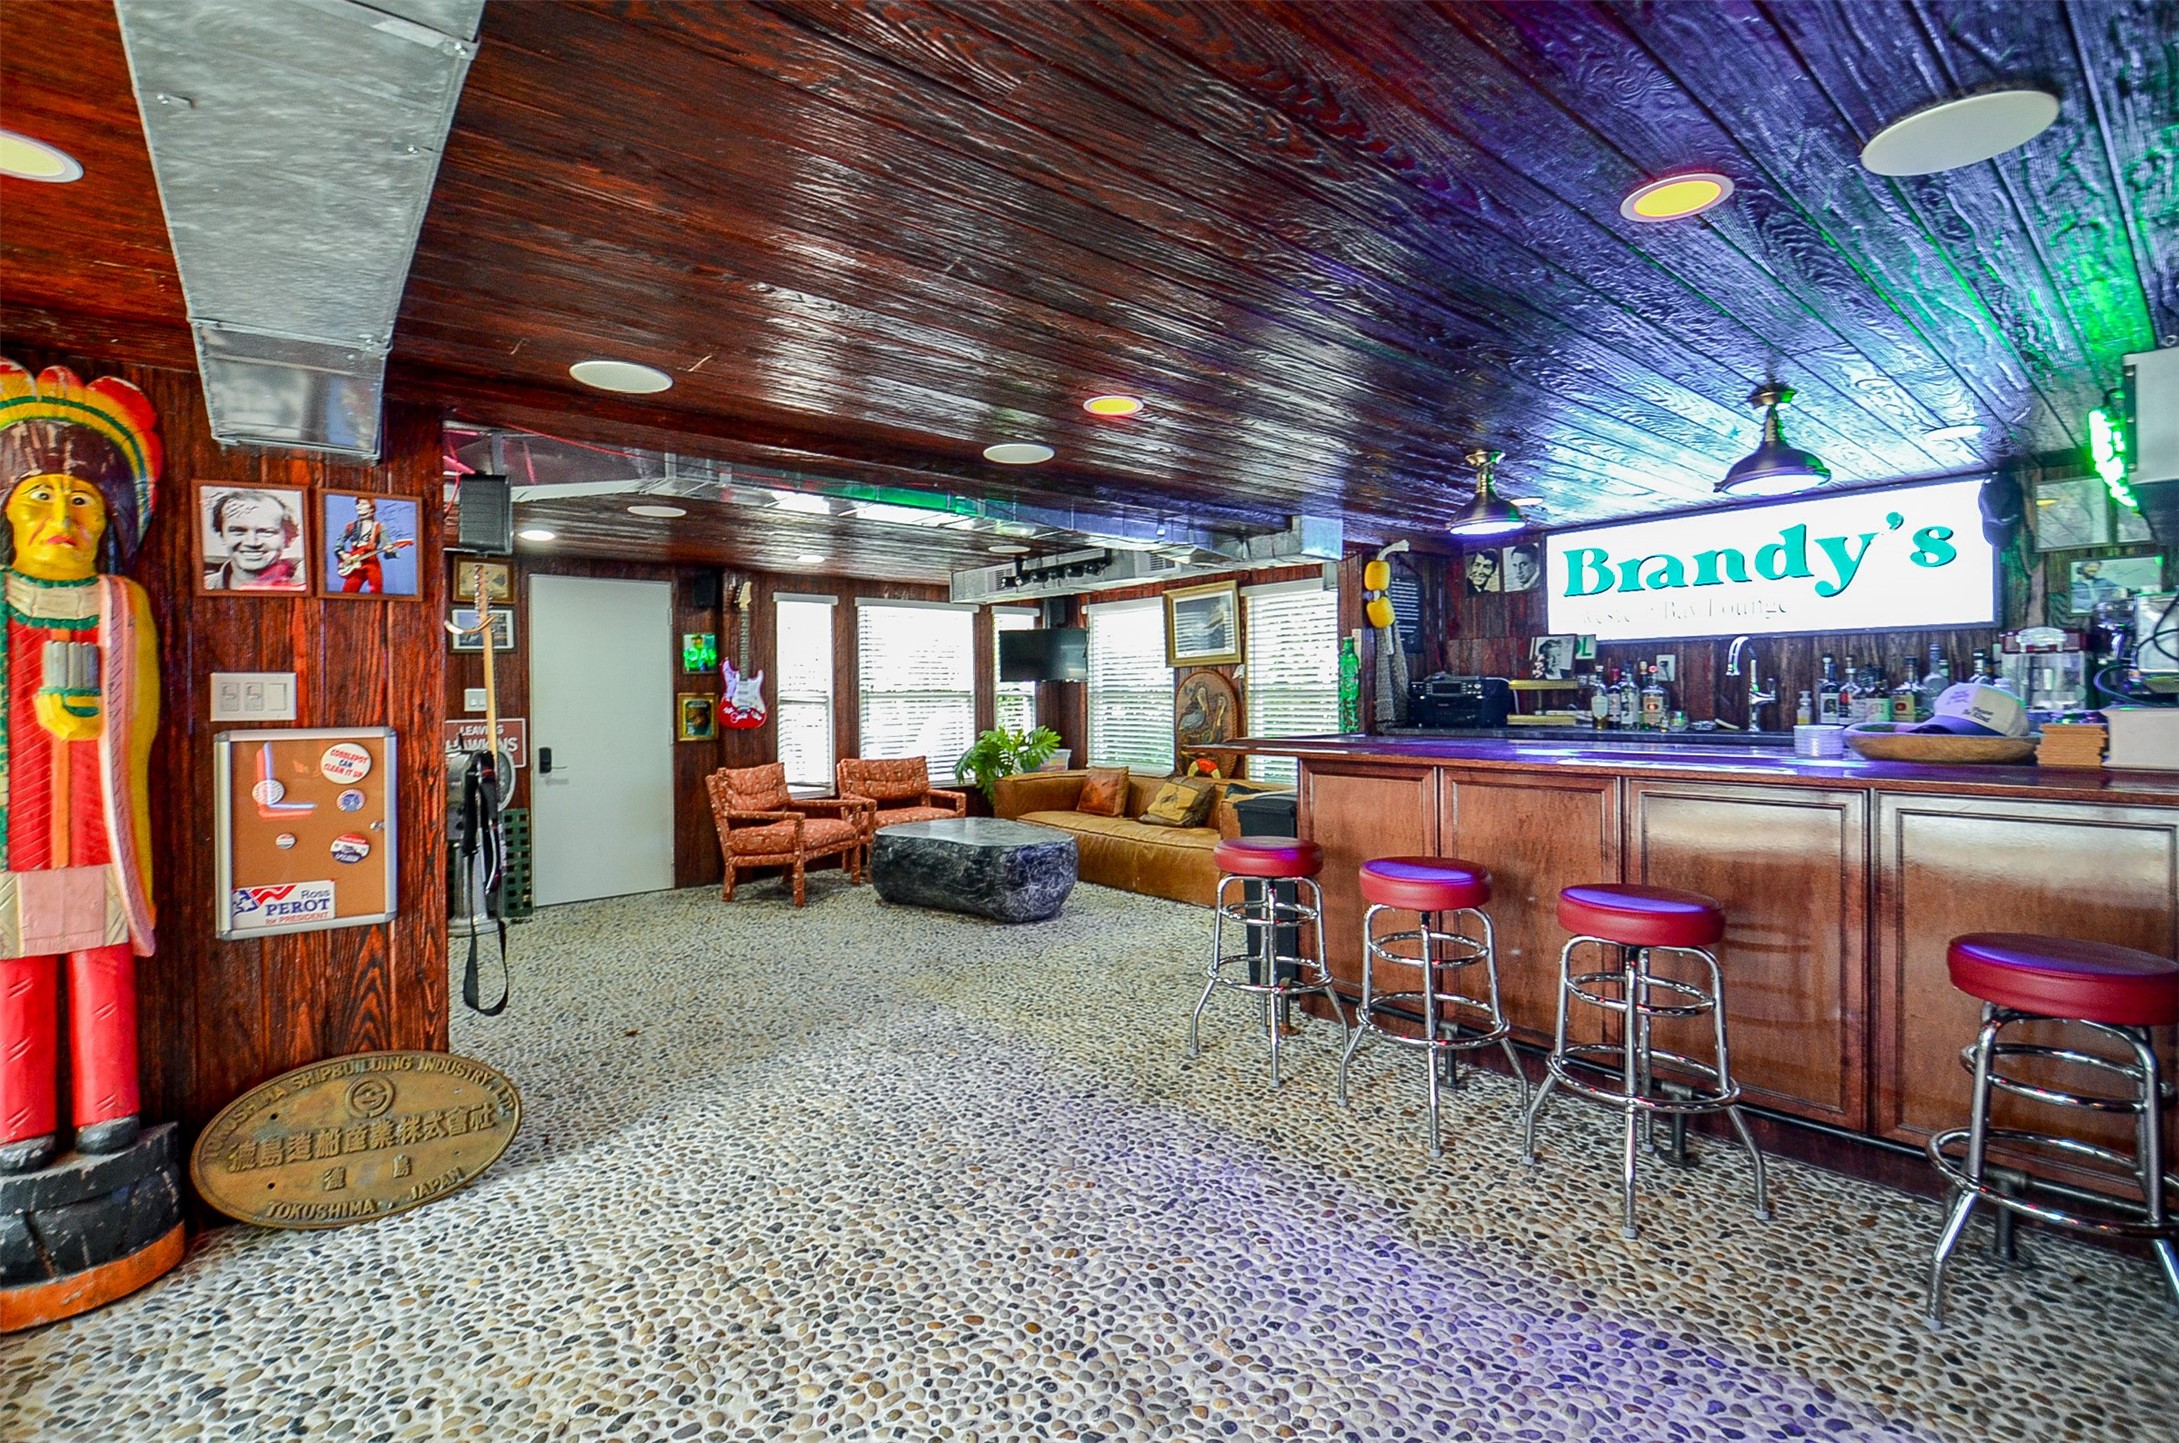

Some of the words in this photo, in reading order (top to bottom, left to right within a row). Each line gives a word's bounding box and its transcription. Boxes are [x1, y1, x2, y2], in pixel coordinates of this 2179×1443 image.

[1562, 510, 1958, 598] Brandy's
[456, 724, 505, 736] LEAVIG
[445, 736, 519, 754] HAWKNS
[301, 889, 331, 900] Ross
[265, 898, 330, 917] PEROT
[292, 1056, 413, 1089] SHIPBUILDING
[410, 1166, 465, 1200] JAPAN
